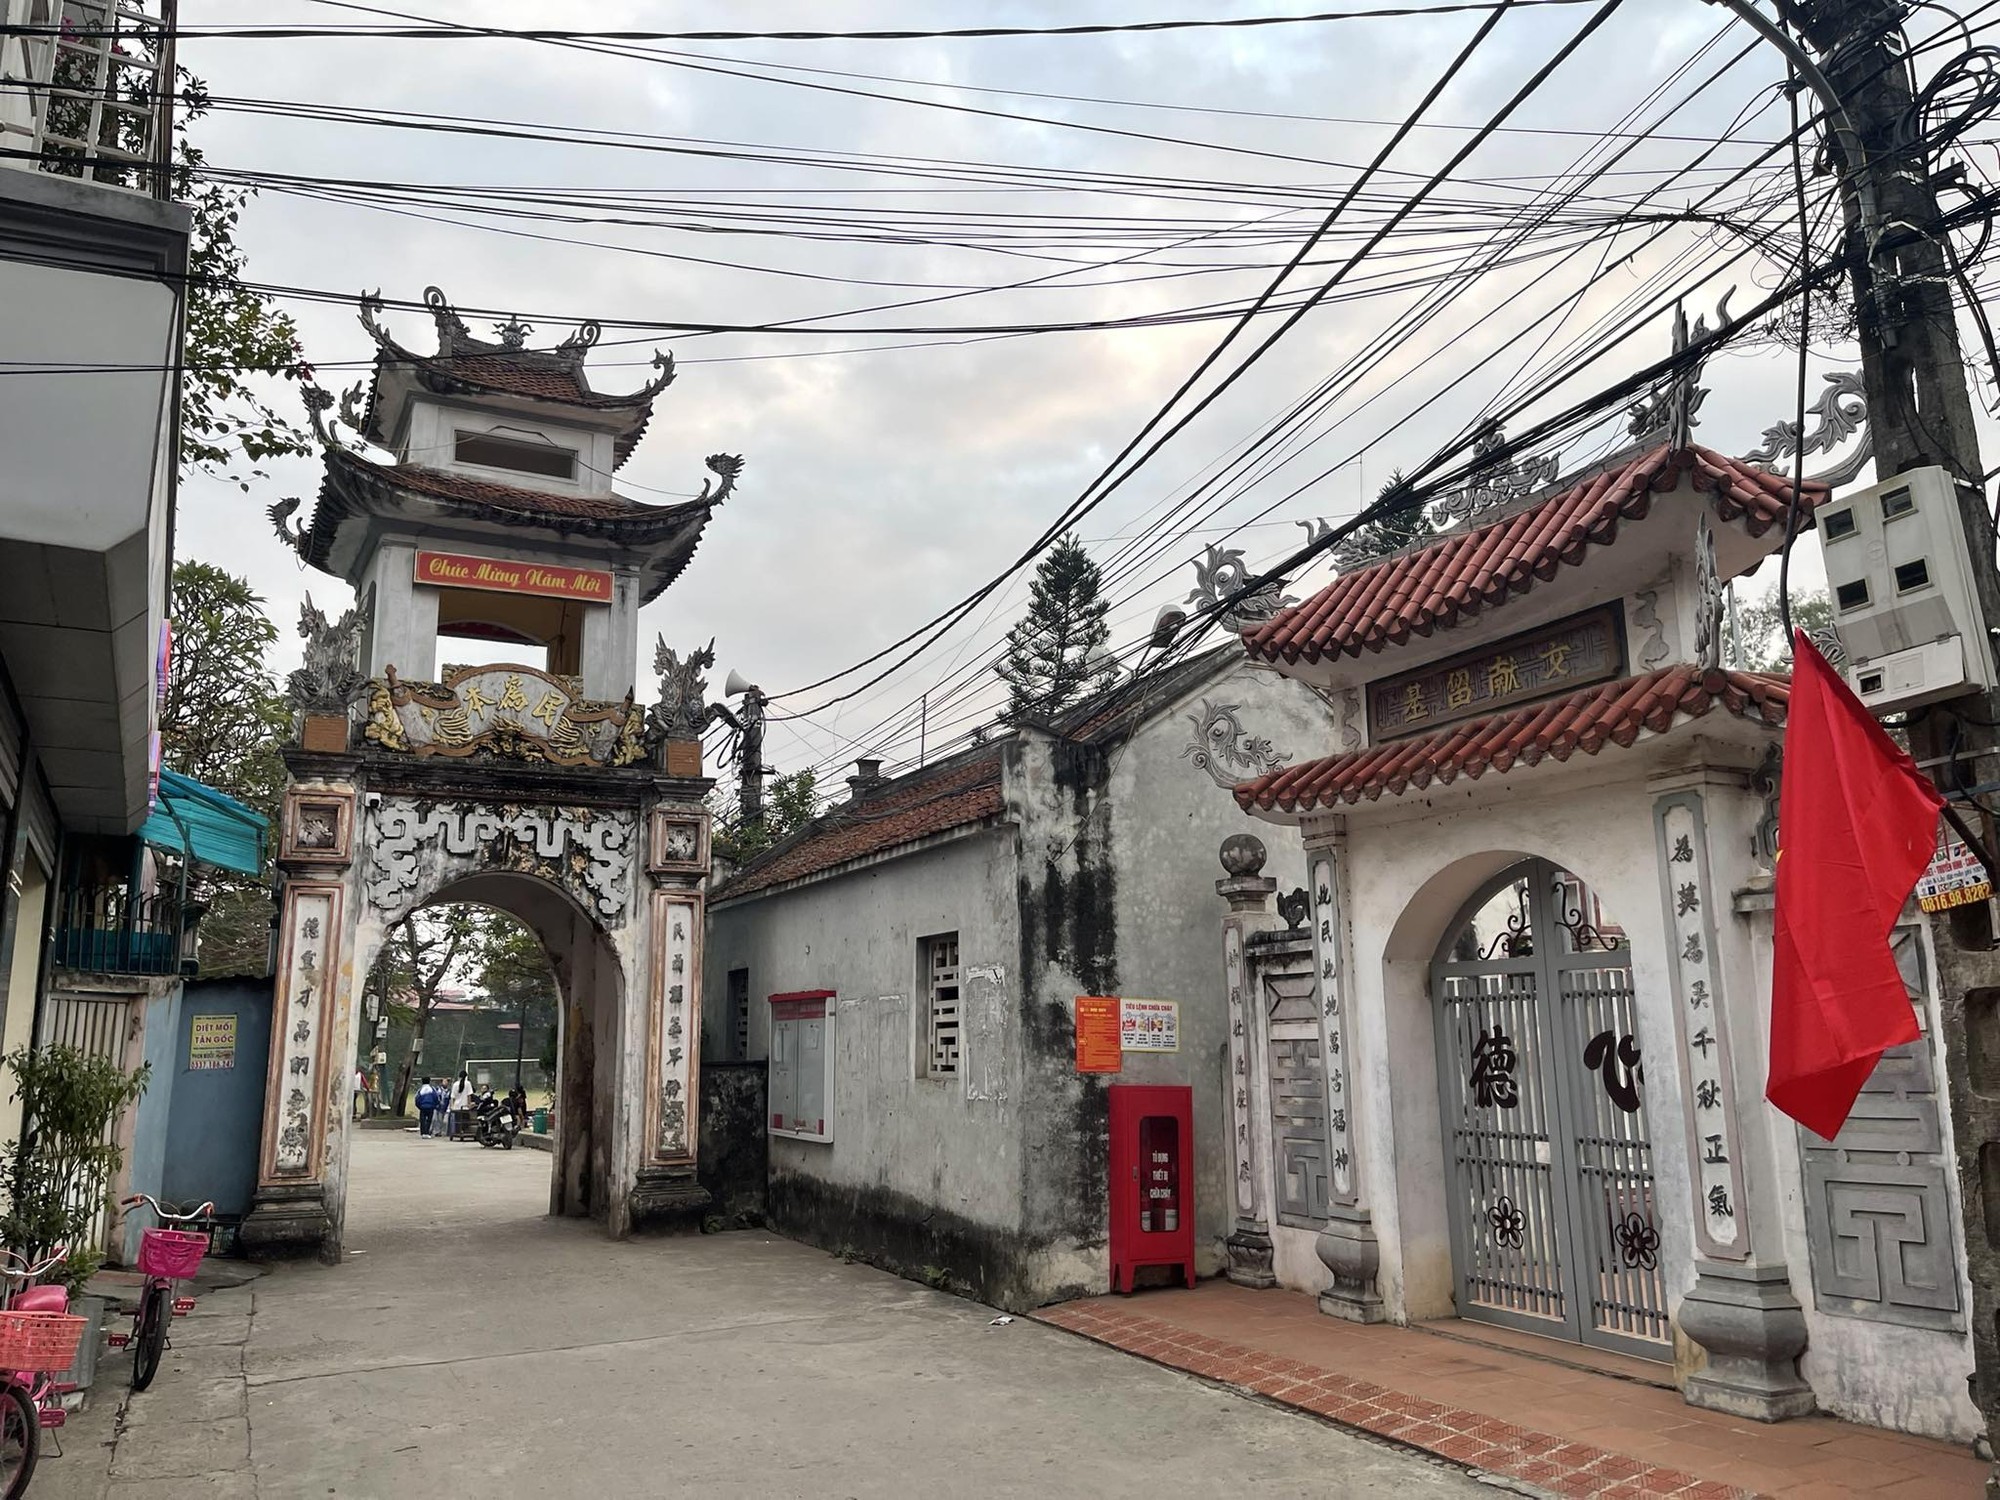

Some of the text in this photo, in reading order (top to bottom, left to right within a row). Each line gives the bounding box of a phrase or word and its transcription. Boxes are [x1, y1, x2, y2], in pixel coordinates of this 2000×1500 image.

[429, 557, 602, 593] Chúc Mừng Năm Mới
[213, 1033, 234, 1044] GỐC
[1469, 1023, 1519, 1110] 德
